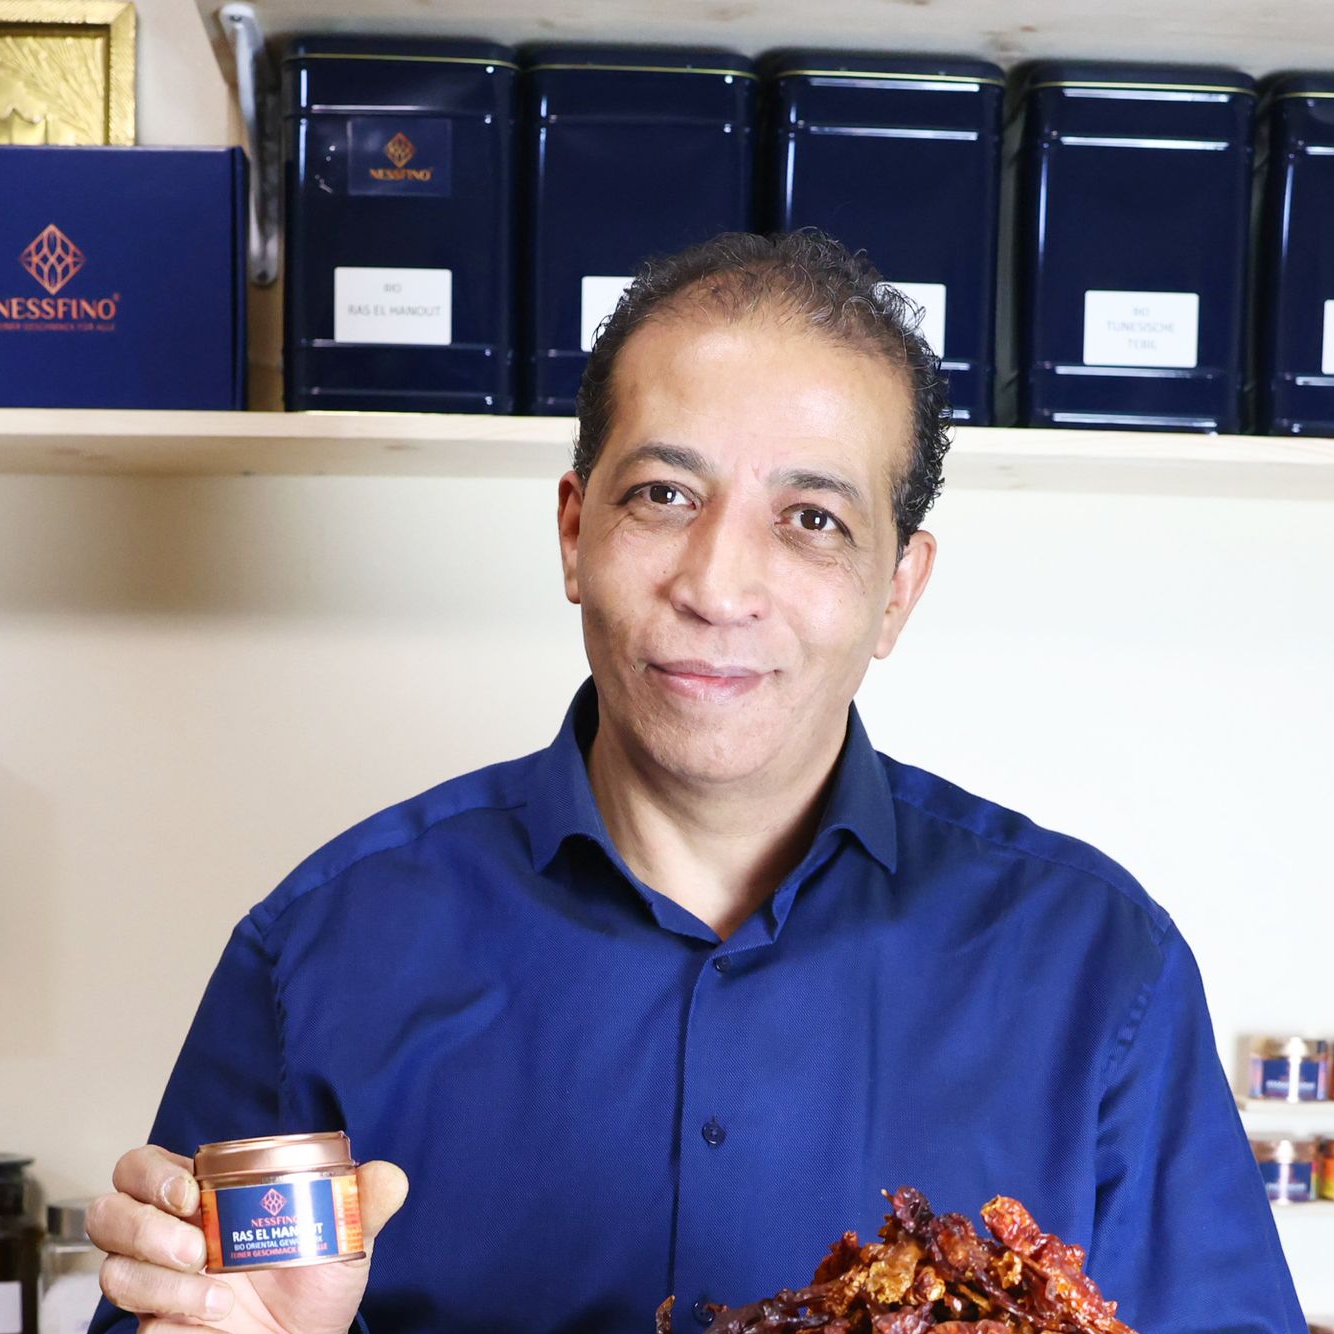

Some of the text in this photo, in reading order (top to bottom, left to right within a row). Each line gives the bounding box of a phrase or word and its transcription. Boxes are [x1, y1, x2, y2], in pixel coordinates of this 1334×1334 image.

[370, 168, 433, 182] NESSFINO
[348, 306, 441, 317] RAS EL HANOUT
[233, 1229, 254, 1243] RAS
[255, 1228, 270, 1241] EL
[234, 1243, 245, 1251] BIO
[246, 1239, 278, 1250] ORIENTAL
